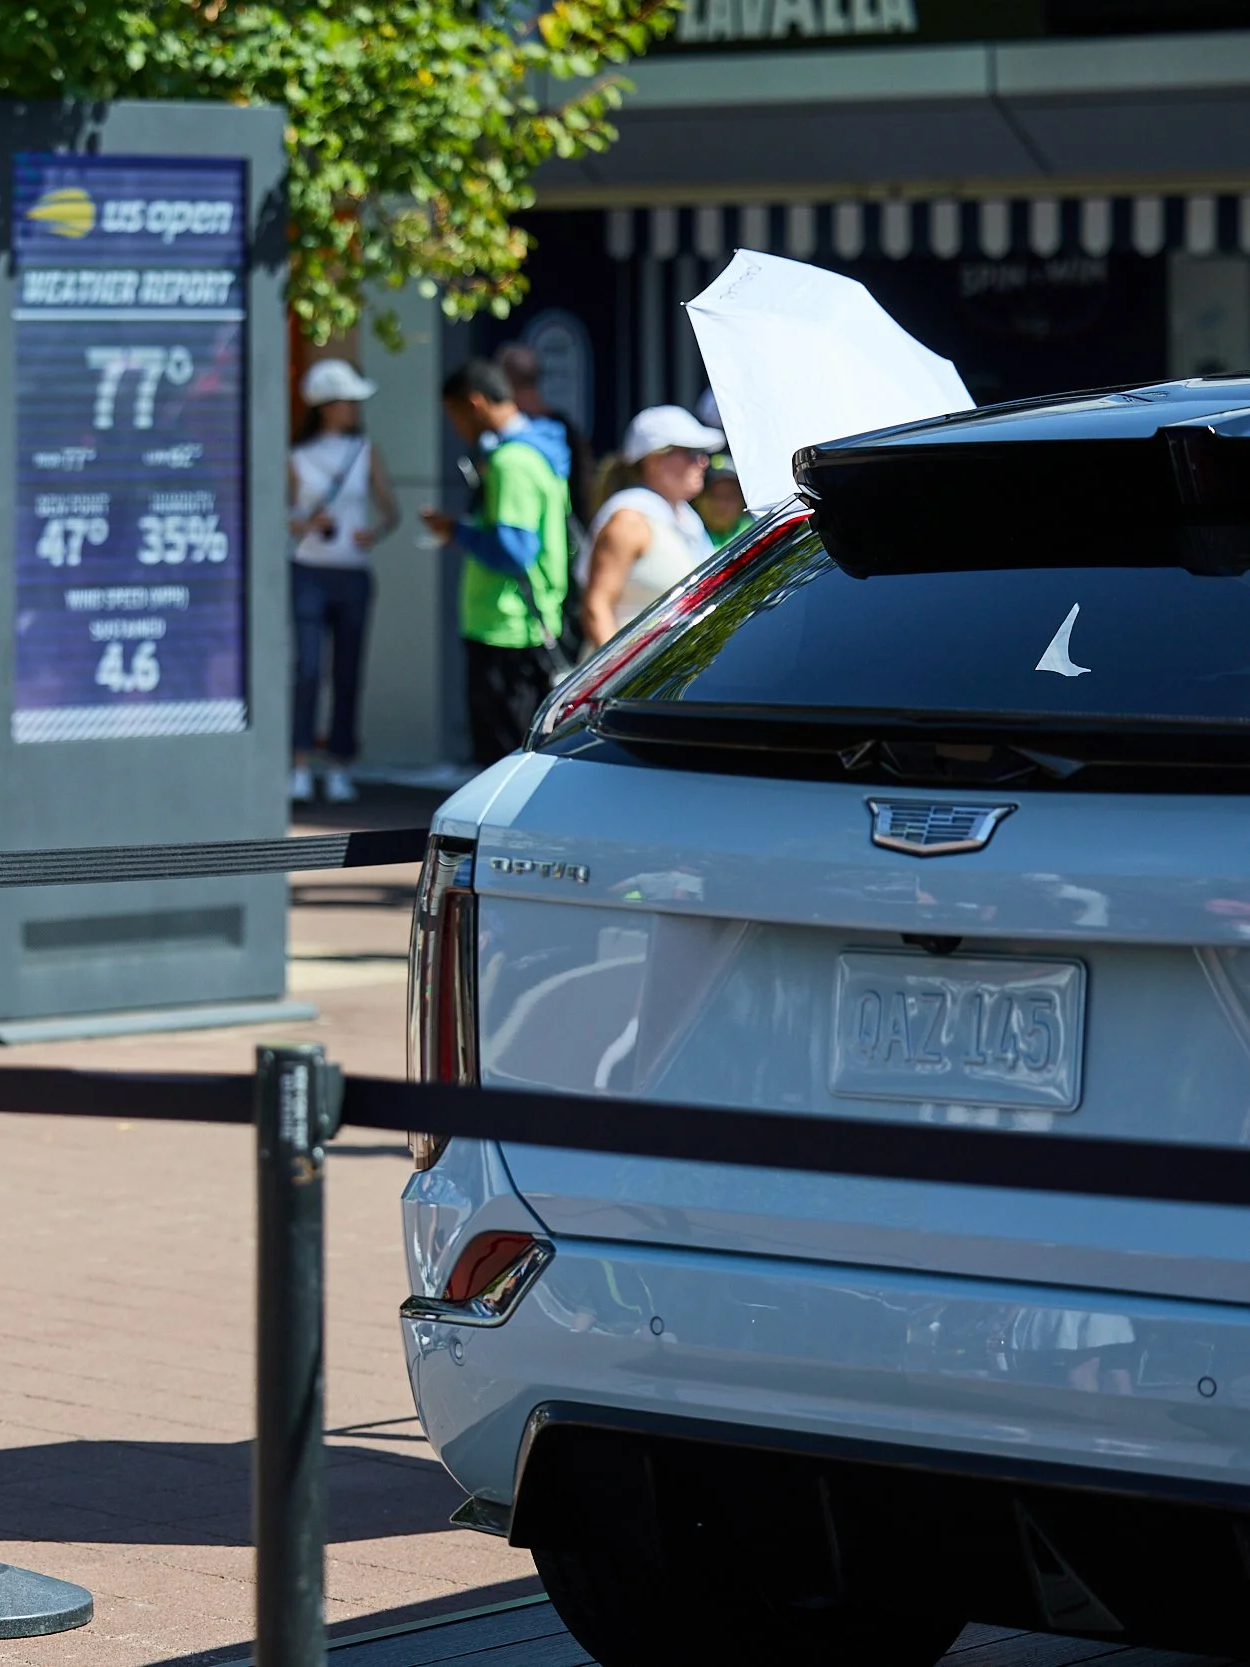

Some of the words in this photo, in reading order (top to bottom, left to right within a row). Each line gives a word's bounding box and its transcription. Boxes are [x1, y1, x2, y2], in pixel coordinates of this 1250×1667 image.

[146, 200, 234, 244] open
[22, 269, 139, 304] WEATHER
[139, 269, 236, 304] REPORT
[137, 514, 229, 565] 35%
[95, 641, 161, 692] 4.6
[963, 992, 1053, 1073] 145
